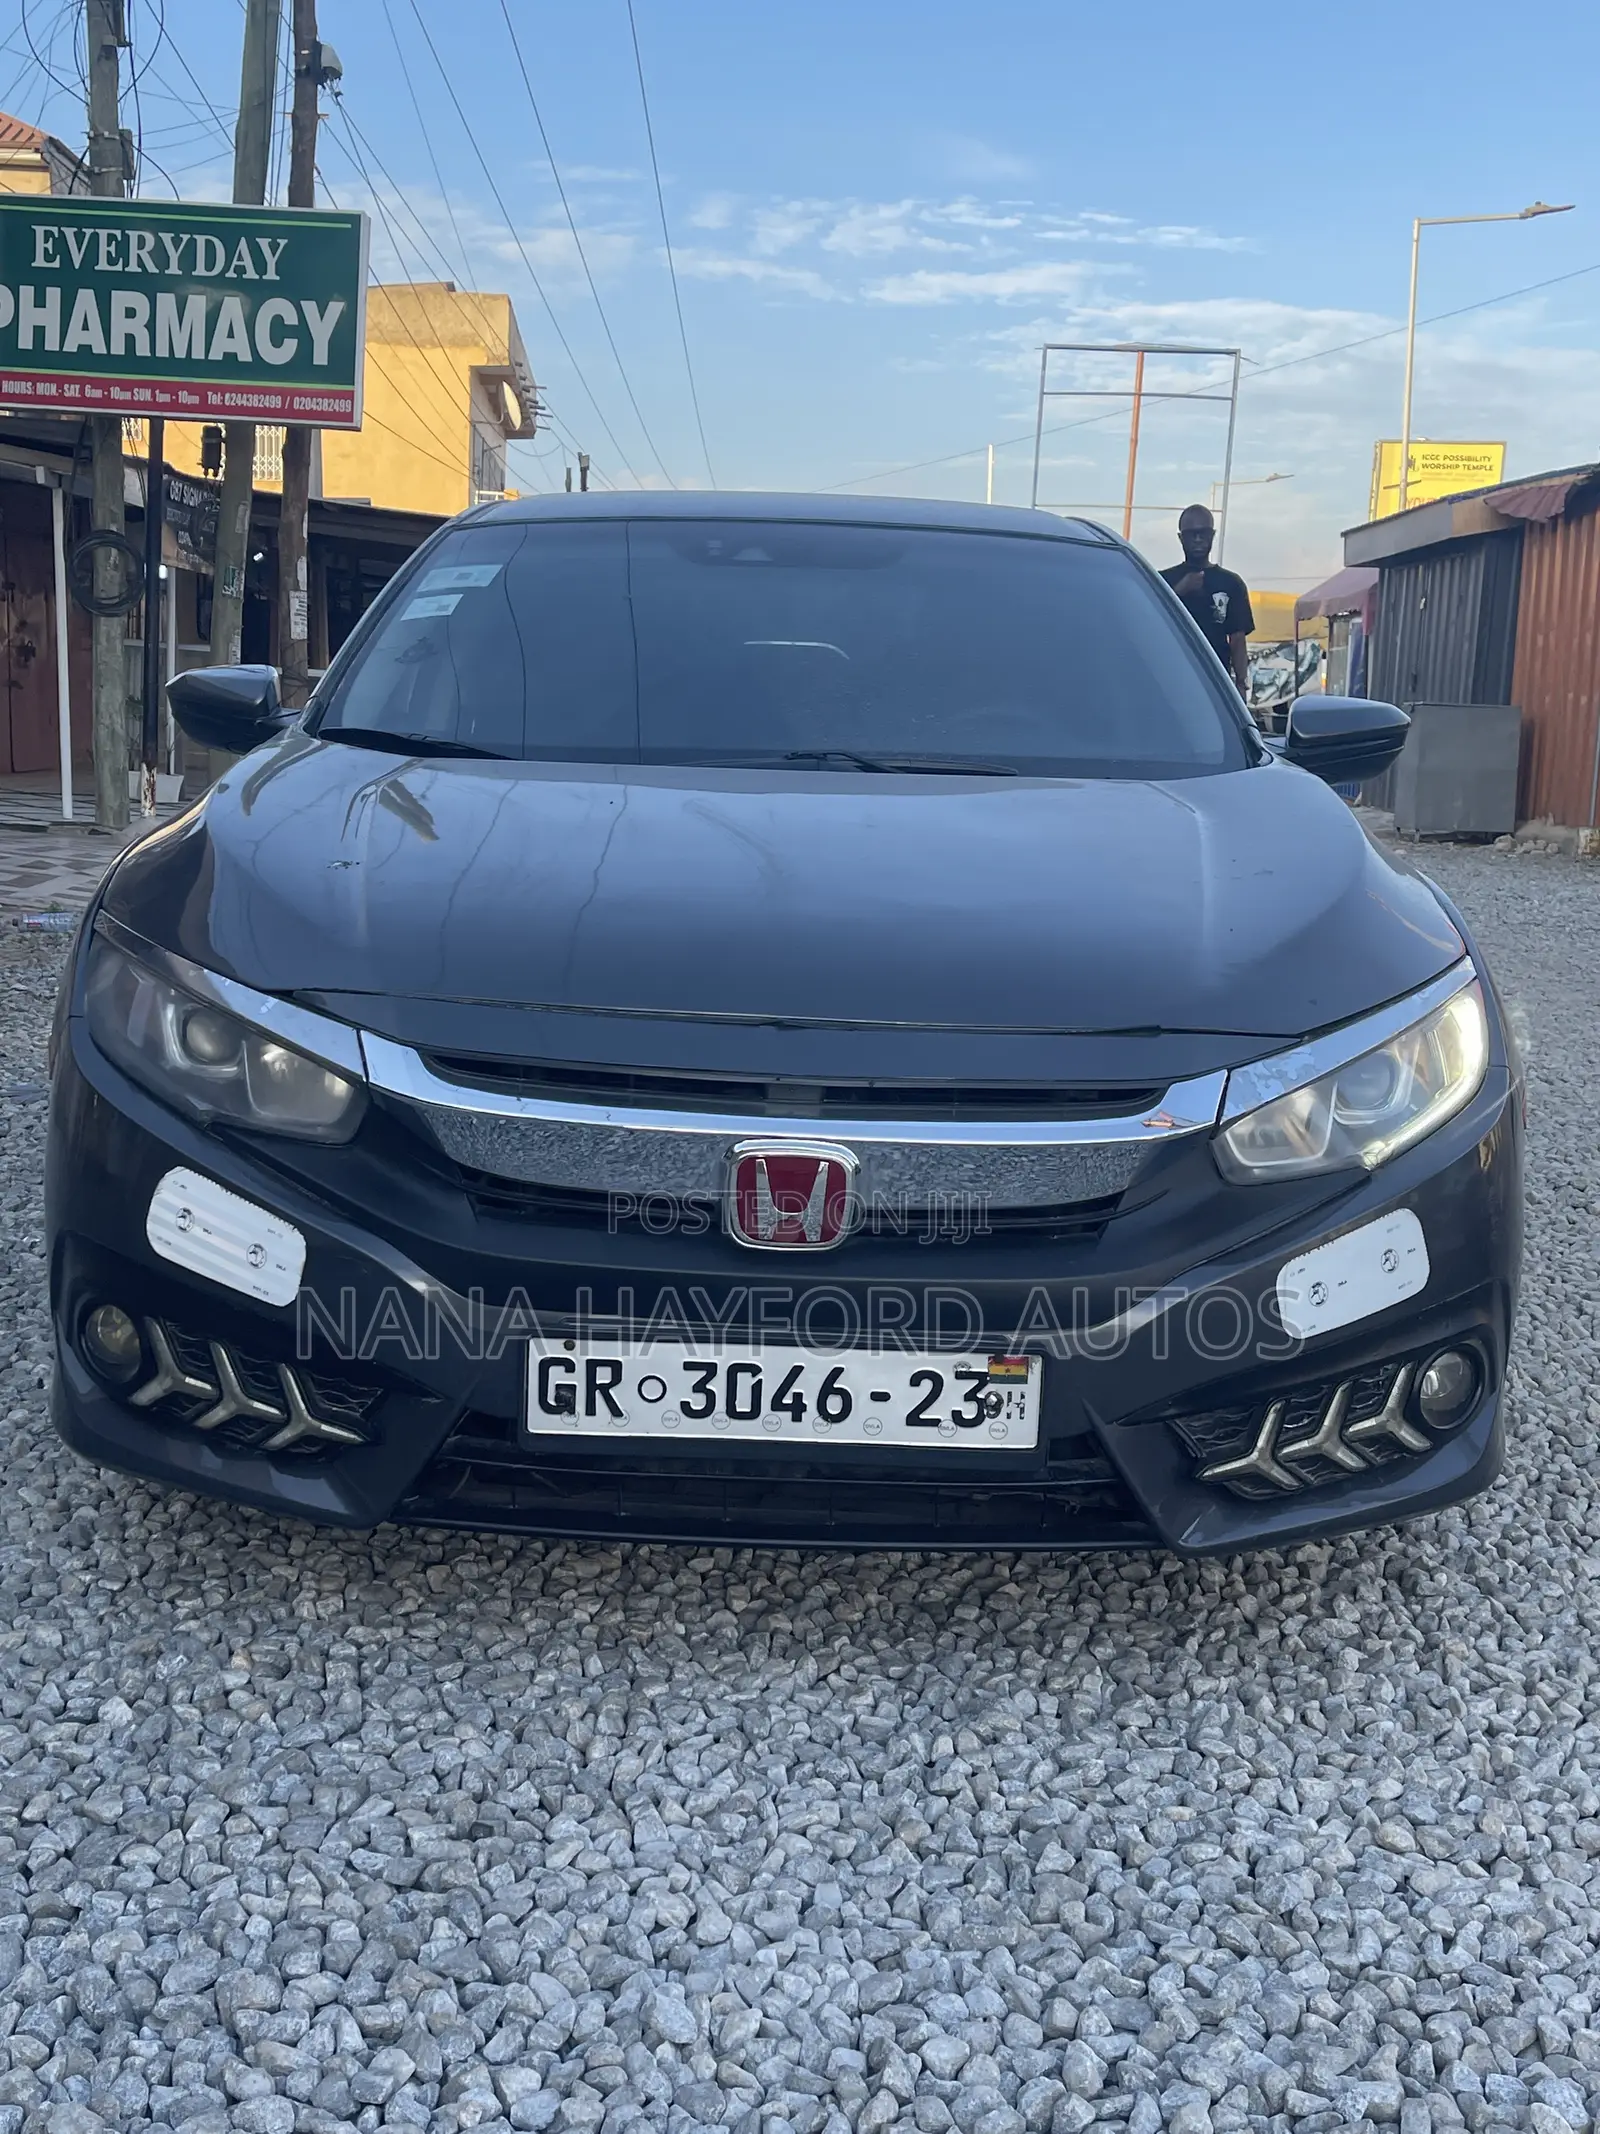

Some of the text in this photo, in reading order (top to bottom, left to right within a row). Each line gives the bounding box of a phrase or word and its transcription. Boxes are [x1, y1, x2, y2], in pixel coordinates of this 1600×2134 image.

[31, 225, 288, 280] EVERYDAY
[2, 380, 35, 395] HOURS:
[85, 385, 102, 398] 6am
[110, 387, 131, 400] 10pm
[178, 390, 199, 404] 10pm
[207, 391, 223, 404] Tel:
[293, 397, 352, 412] 0204382499
[1421, 463, 1494, 472] WORSHIP TEMPLE
[538, 1356, 624, 1417] GR
[679, 1361, 853, 1424] 3046
[905, 1369, 990, 1429] 23
